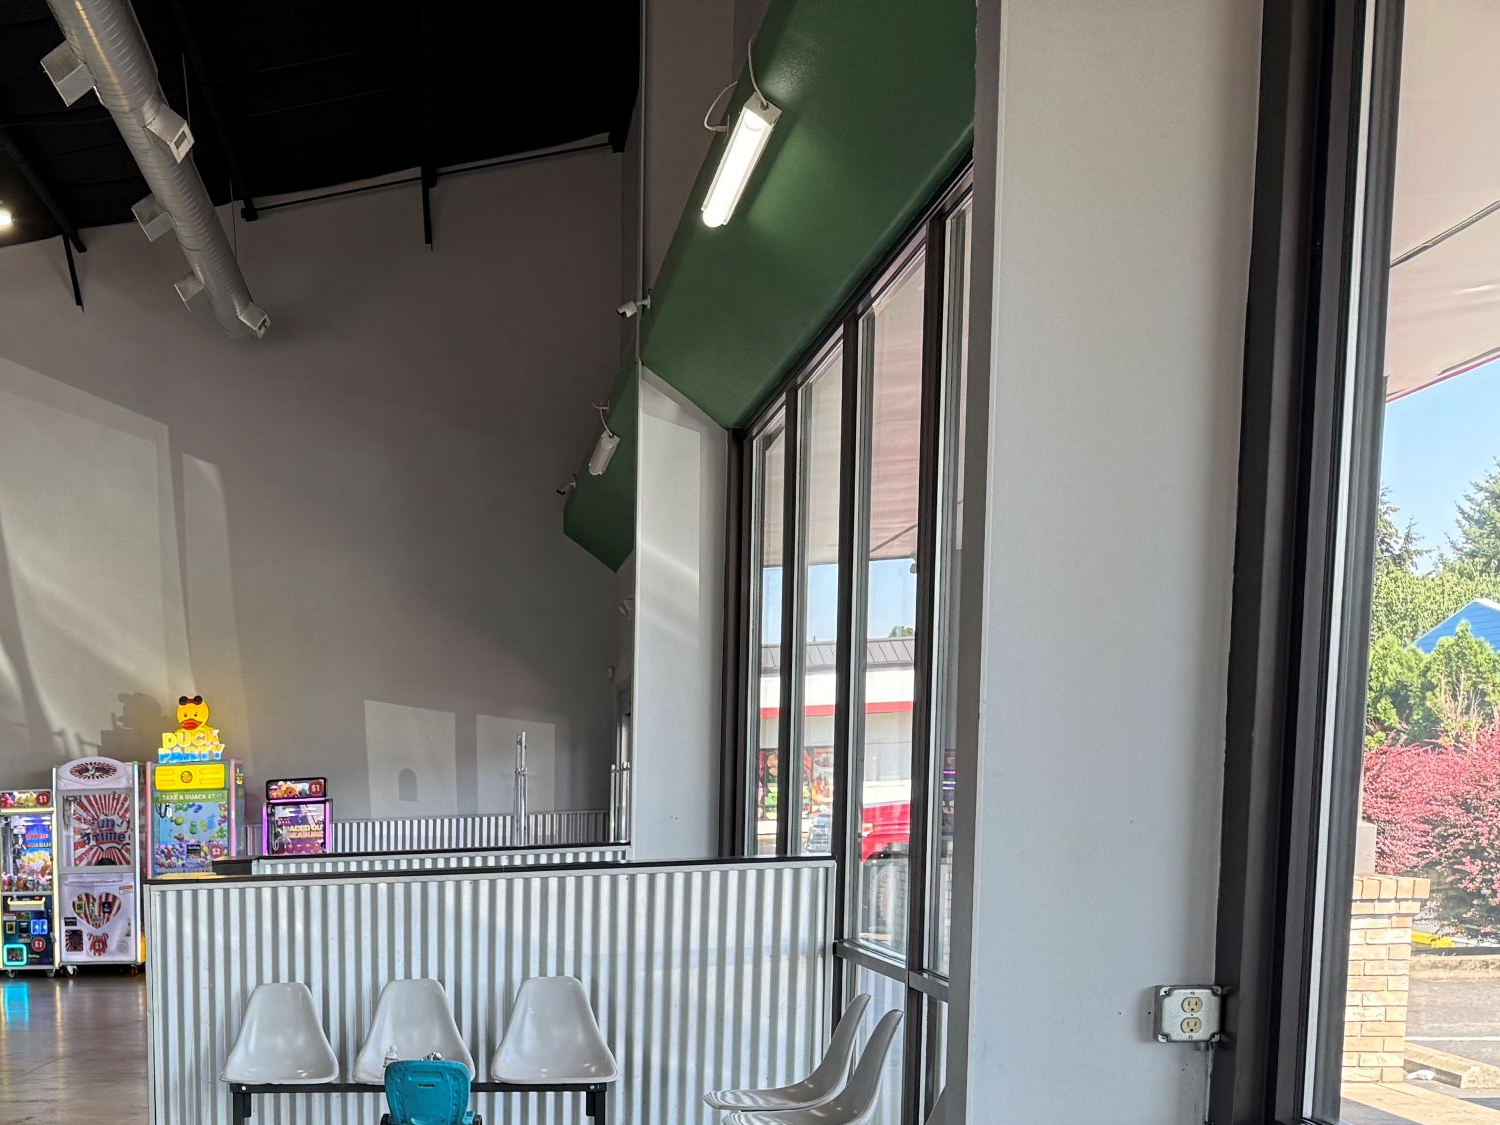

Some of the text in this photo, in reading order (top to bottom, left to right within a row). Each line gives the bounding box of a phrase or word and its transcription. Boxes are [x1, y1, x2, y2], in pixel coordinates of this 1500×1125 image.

[162, 729, 220, 748] DUCK
[158, 744, 225, 763] PARTY
[311, 784, 320, 792] $1
[212, 847, 221, 855] $2
